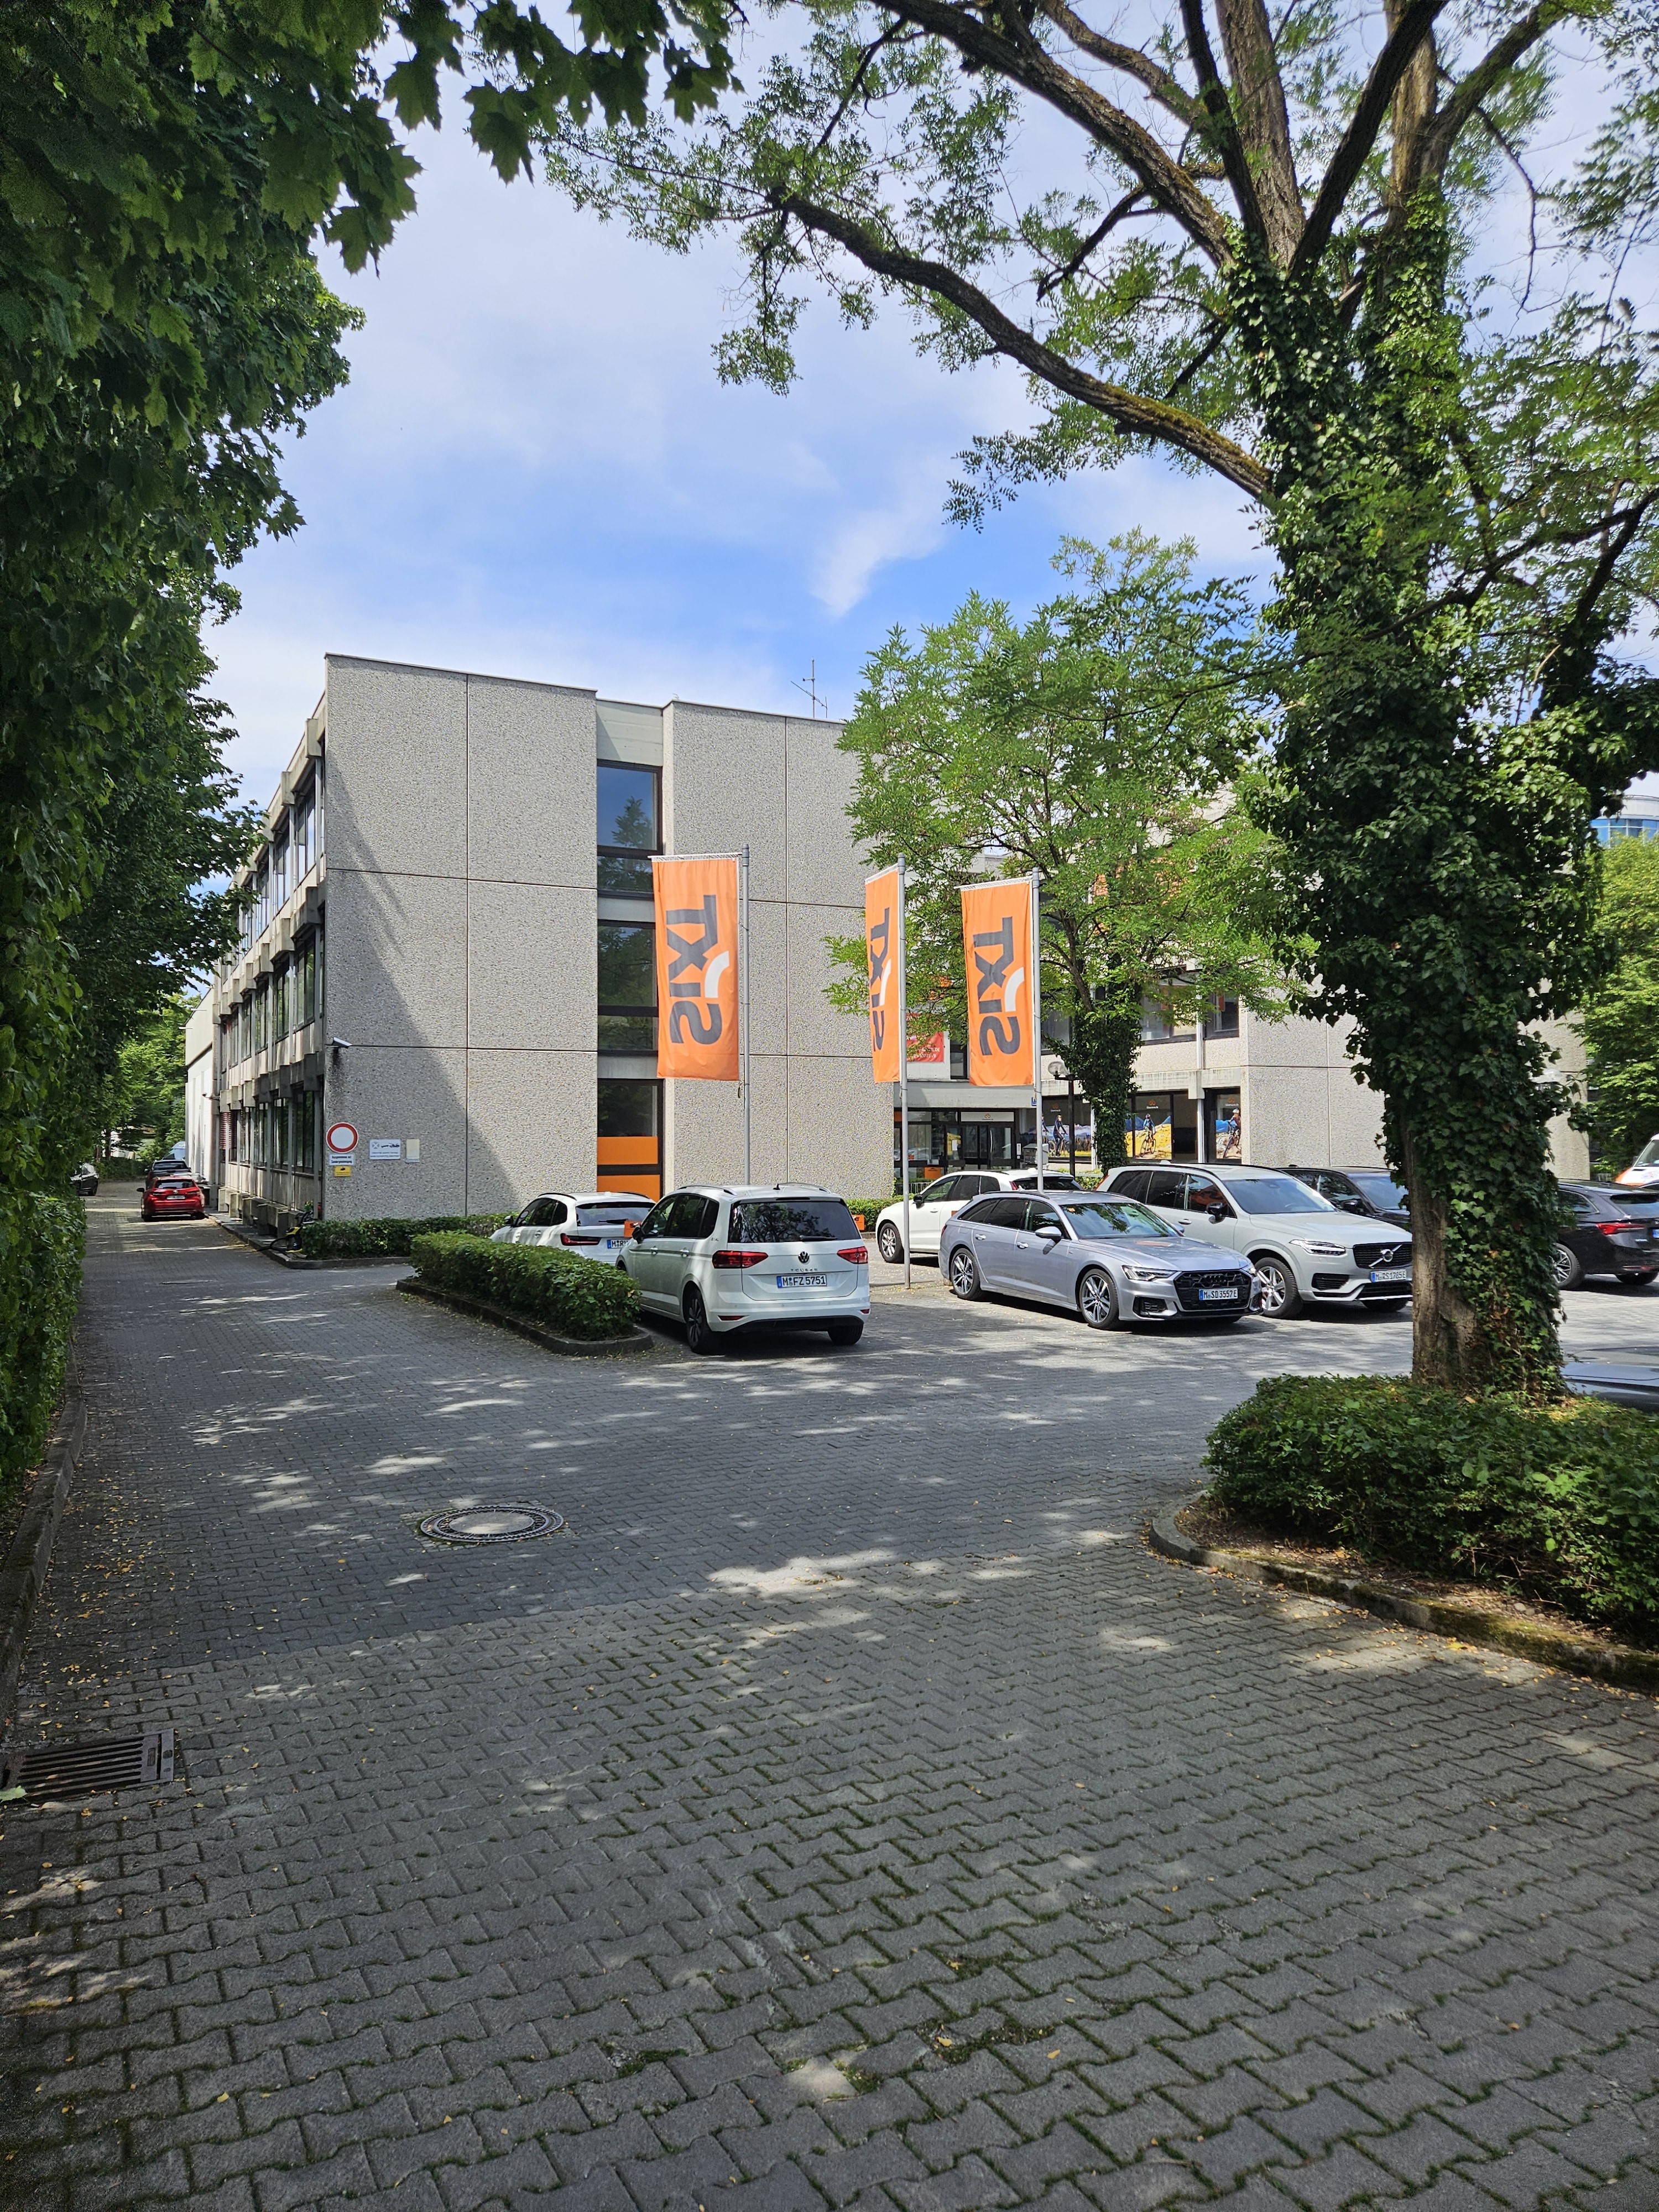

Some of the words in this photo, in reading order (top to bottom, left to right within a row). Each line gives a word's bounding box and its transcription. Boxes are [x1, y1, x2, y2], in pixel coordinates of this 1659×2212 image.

[782, 1277, 789, 1286] M
[793, 1276, 804, 1286] FZ
[805, 1276, 826, 1285] 5751
[1211, 1290, 1219, 1298] SD
